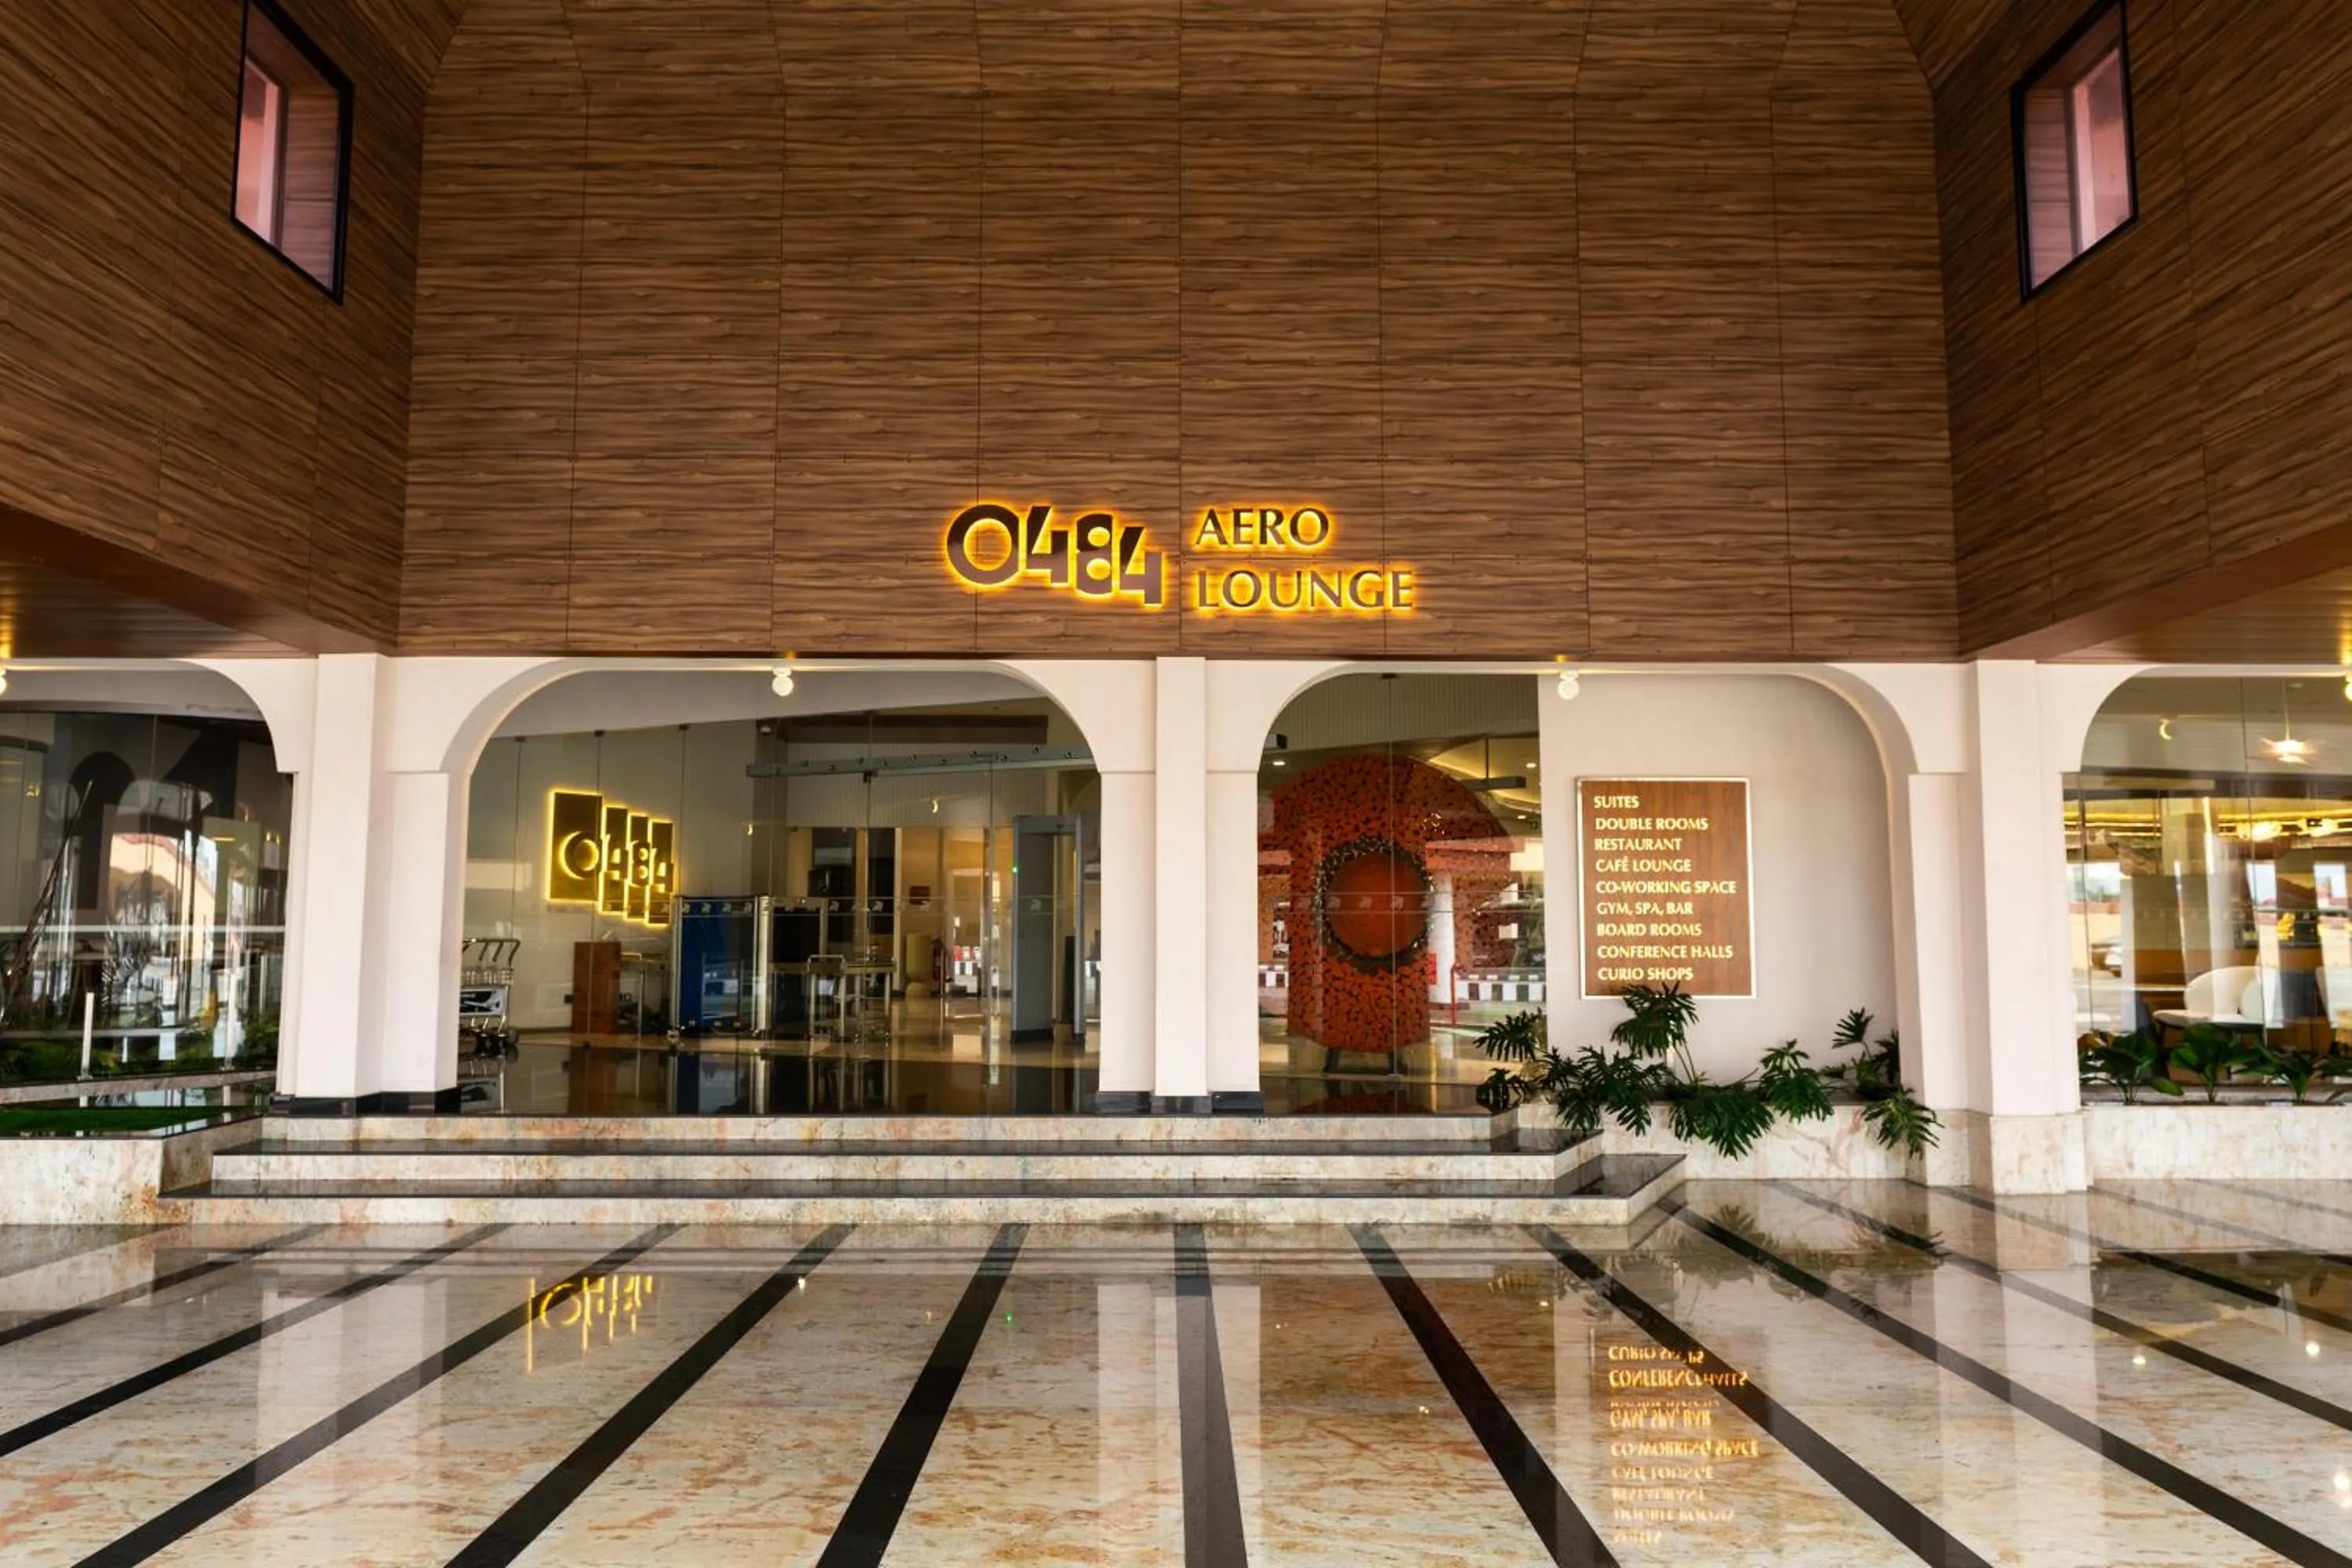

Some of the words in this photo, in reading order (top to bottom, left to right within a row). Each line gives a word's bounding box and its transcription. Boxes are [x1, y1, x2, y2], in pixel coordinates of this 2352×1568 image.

[1194, 508, 1330, 546] AERO
[947, 504, 1162, 605] 0484
[1196, 569, 1413, 608] LOUNGE
[1594, 796, 1639, 808] SUITES
[1595, 818, 1652, 830] DOUBLE
[1656, 818, 1708, 830] ROOMS
[1595, 839, 1682, 851] RESTAURANT
[1595, 856, 1628, 872] CAFÉ
[1633, 859, 1691, 872] LOUNGE
[1596, 881, 1691, 894] CO-WORKING
[1695, 881, 1737, 894] SPACE
[1597, 903, 1632, 916] GYM,
[1635, 903, 1663, 916] SPA,
[1667, 903, 1693, 915] BAR
[1597, 924, 1646, 936] BOARD
[1650, 924, 1702, 936] ROOMS
[1597, 946, 1687, 958] CONFERENCE
[1691, 946, 1733, 958] HALLS
[1598, 968, 1643, 980] CURIO
[1647, 968, 1693, 980] SHOPS
